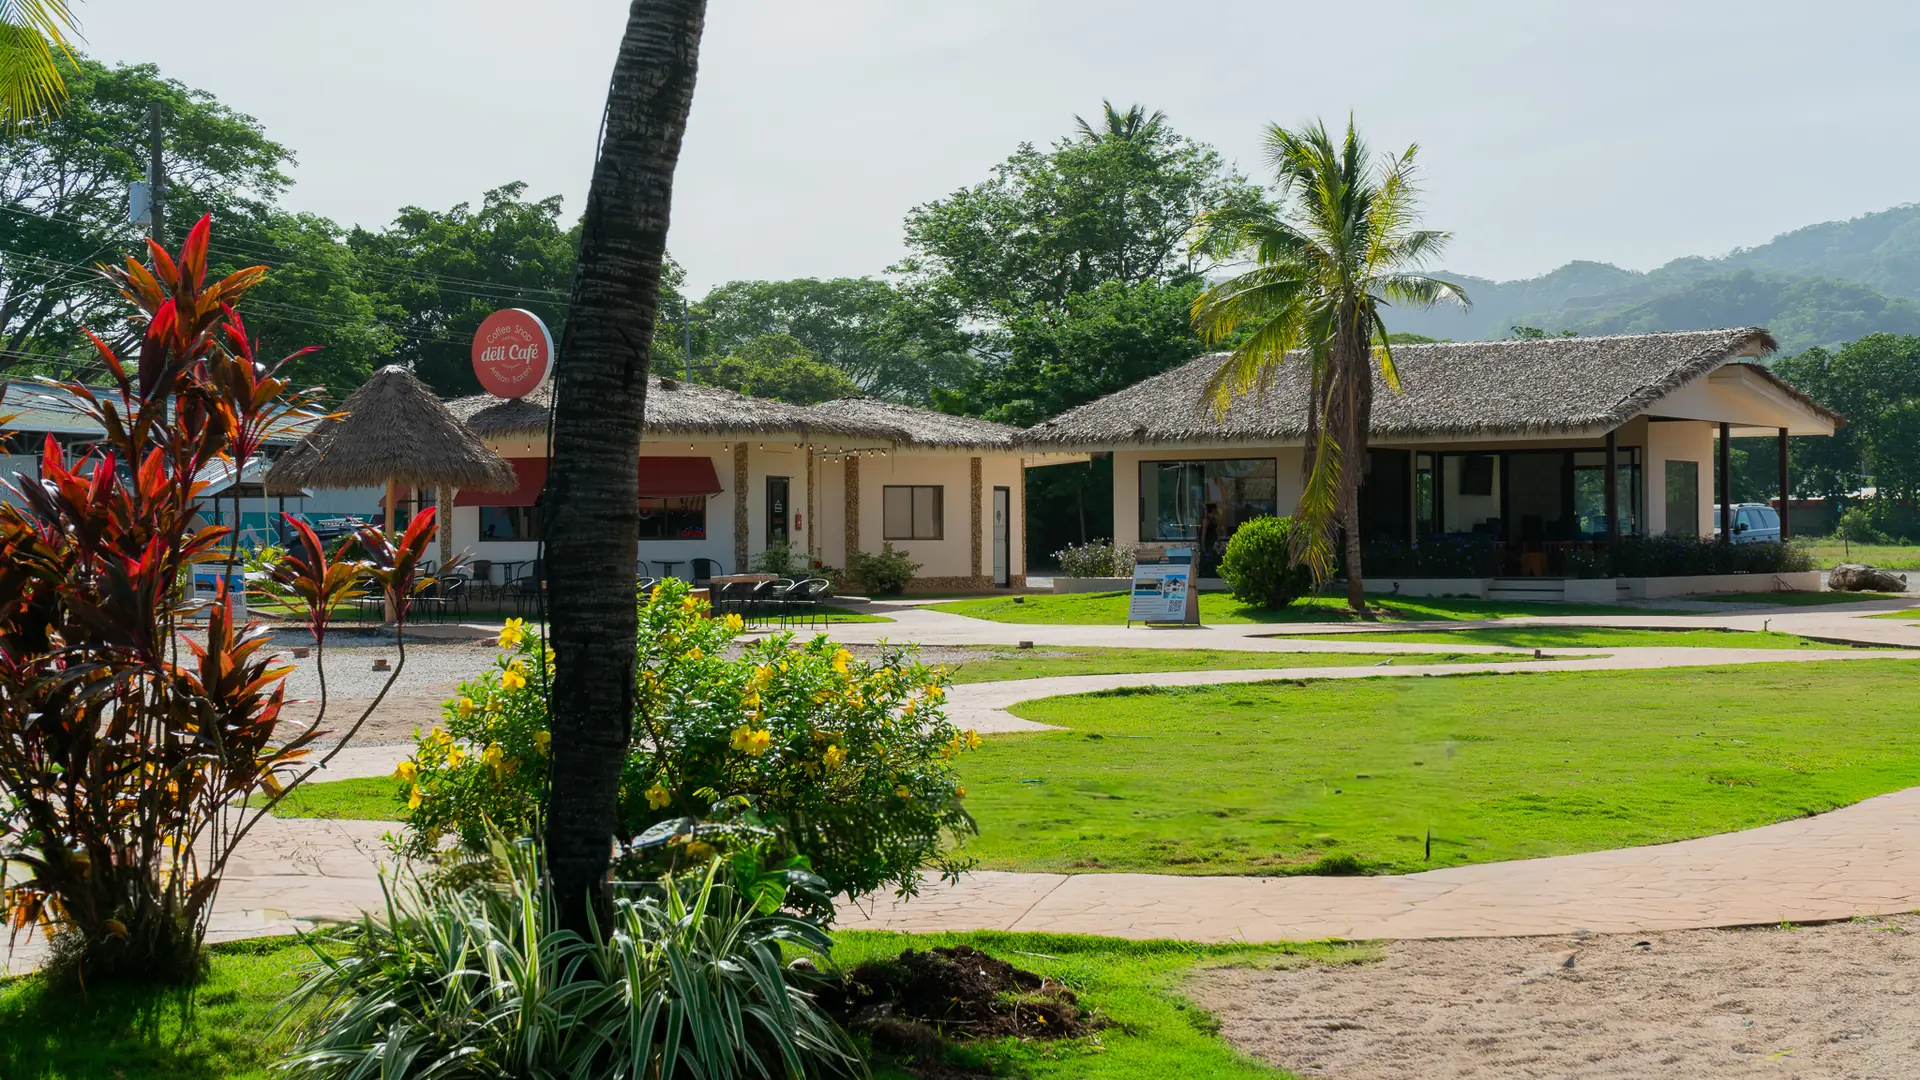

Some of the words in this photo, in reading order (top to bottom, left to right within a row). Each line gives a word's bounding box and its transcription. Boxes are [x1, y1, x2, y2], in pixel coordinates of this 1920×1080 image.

[487, 325, 511, 344] Coffee
[514, 324, 533, 342] Shop
[481, 346, 507, 362] dëli
[508, 343, 539, 364] Café
[490, 366, 510, 383] Artisan
[512, 365, 533, 384] Bakery
